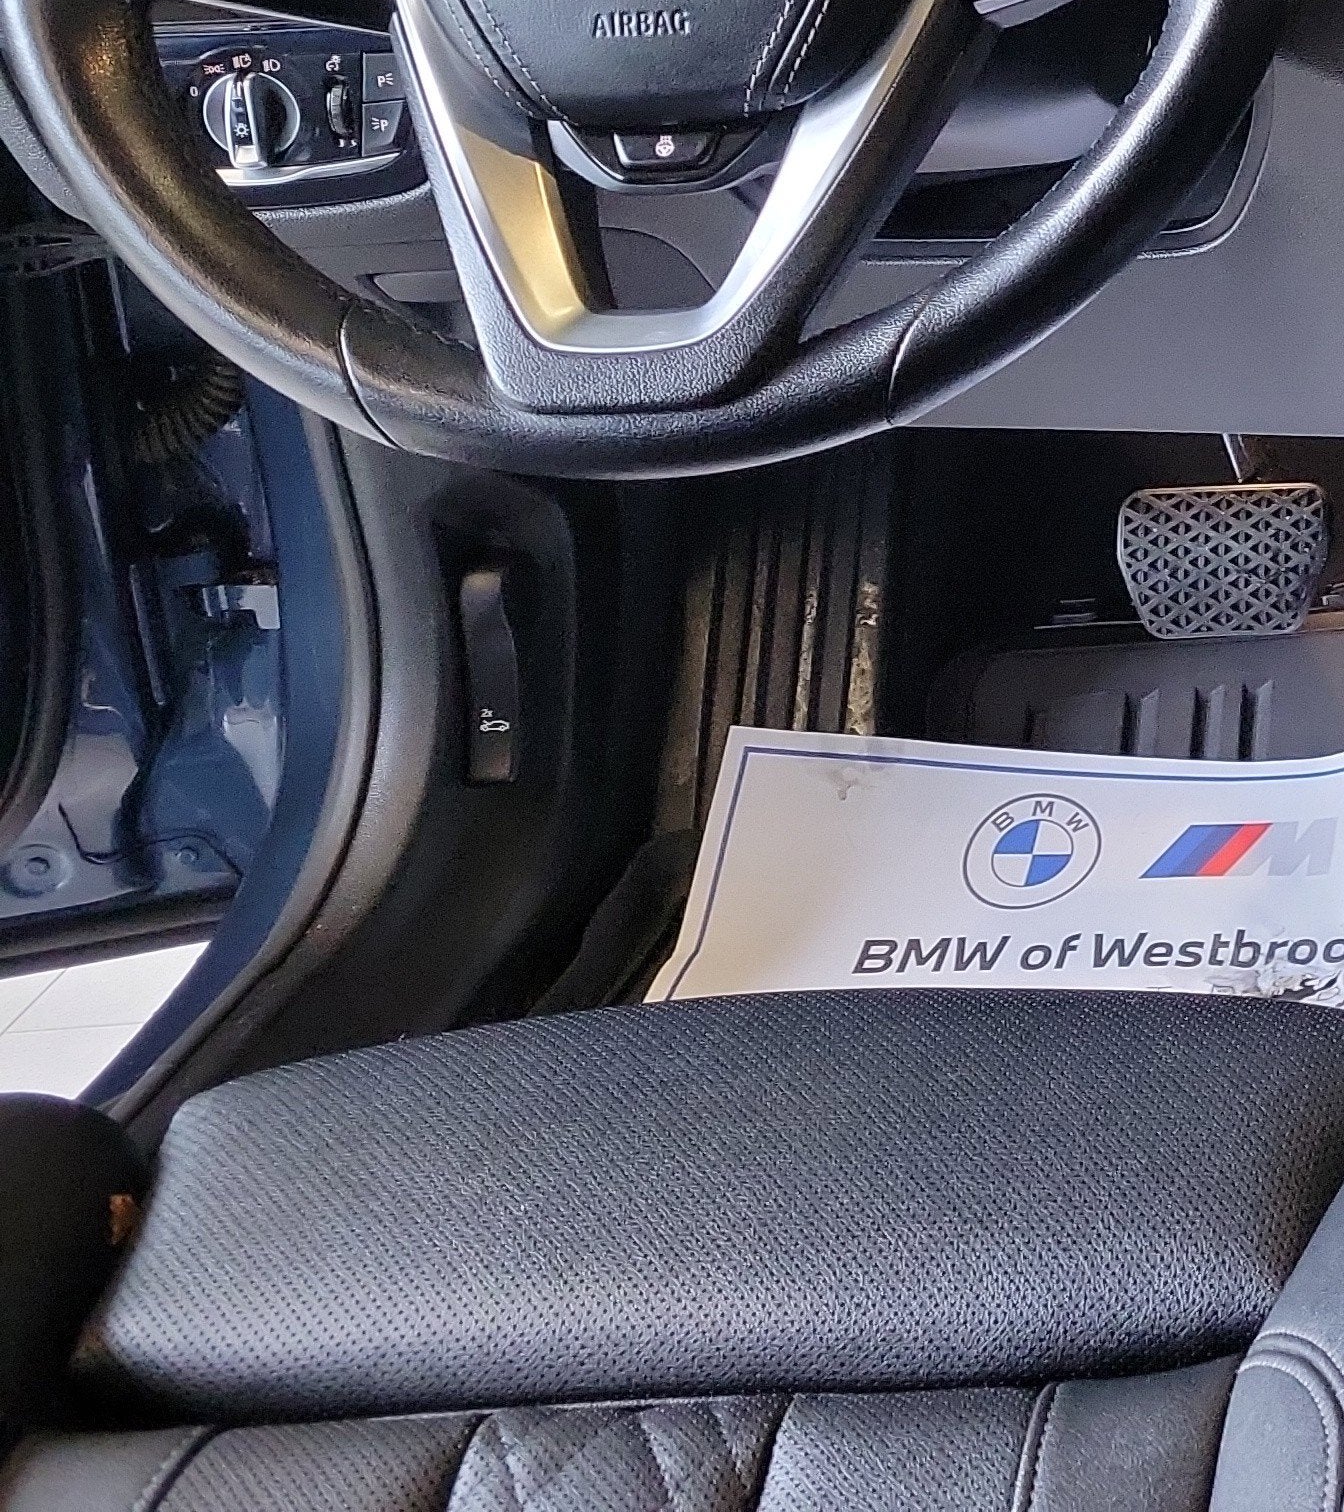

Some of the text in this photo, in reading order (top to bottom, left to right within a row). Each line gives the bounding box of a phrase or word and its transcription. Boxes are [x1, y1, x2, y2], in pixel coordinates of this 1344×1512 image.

[591, 8, 691, 39] AIRBAG
[990, 799, 1090, 834] BMW
[852, 934, 1011, 975] BMW
[1020, 931, 1083, 971] of
